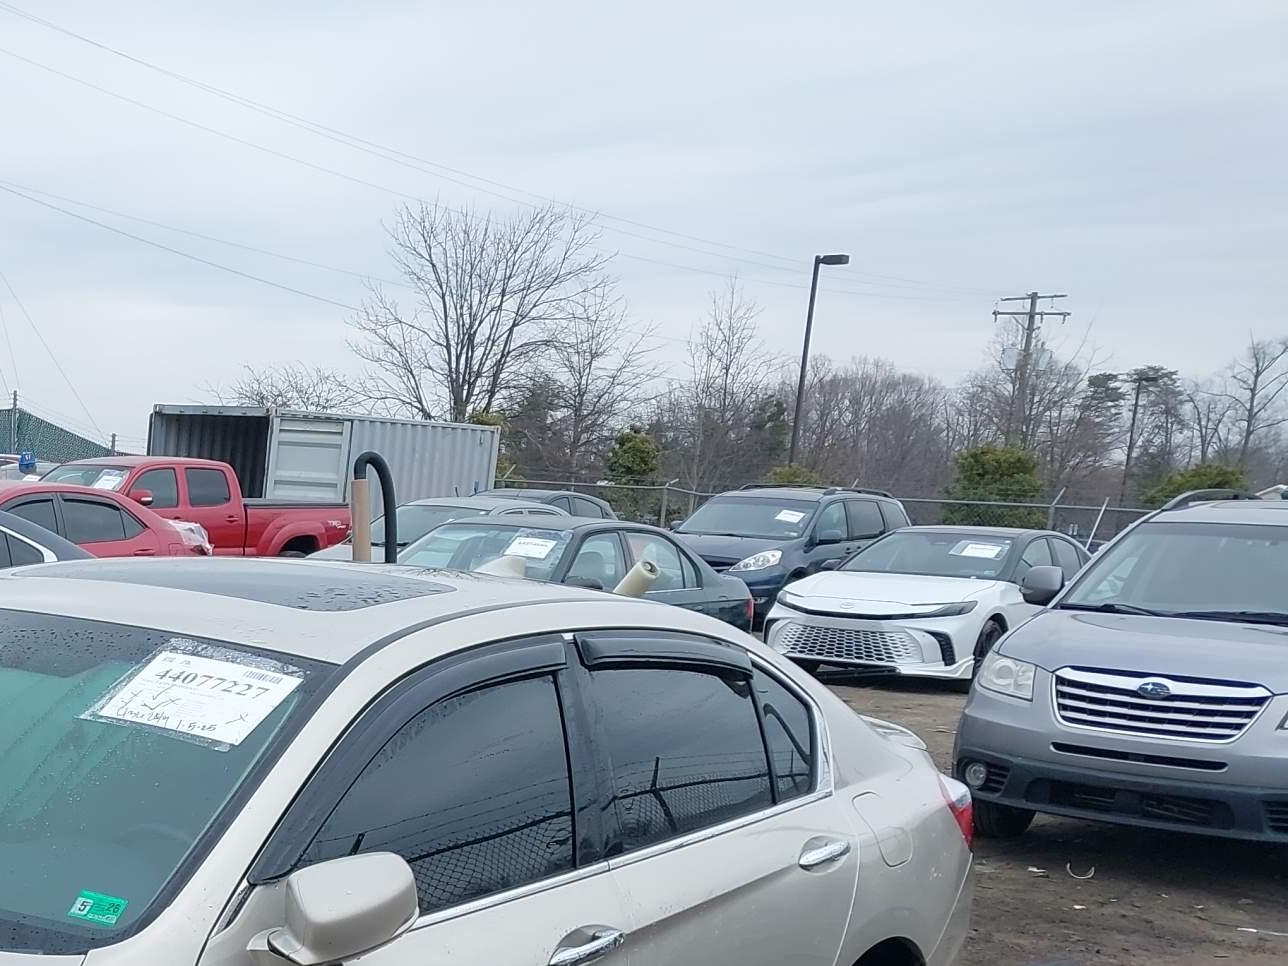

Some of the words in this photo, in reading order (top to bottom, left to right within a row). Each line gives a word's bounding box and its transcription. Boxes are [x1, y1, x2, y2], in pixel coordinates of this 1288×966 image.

[155, 669, 270, 698] 44077227
[78, 901, 90, 911] 5
[107, 903, 120, 913] 26
